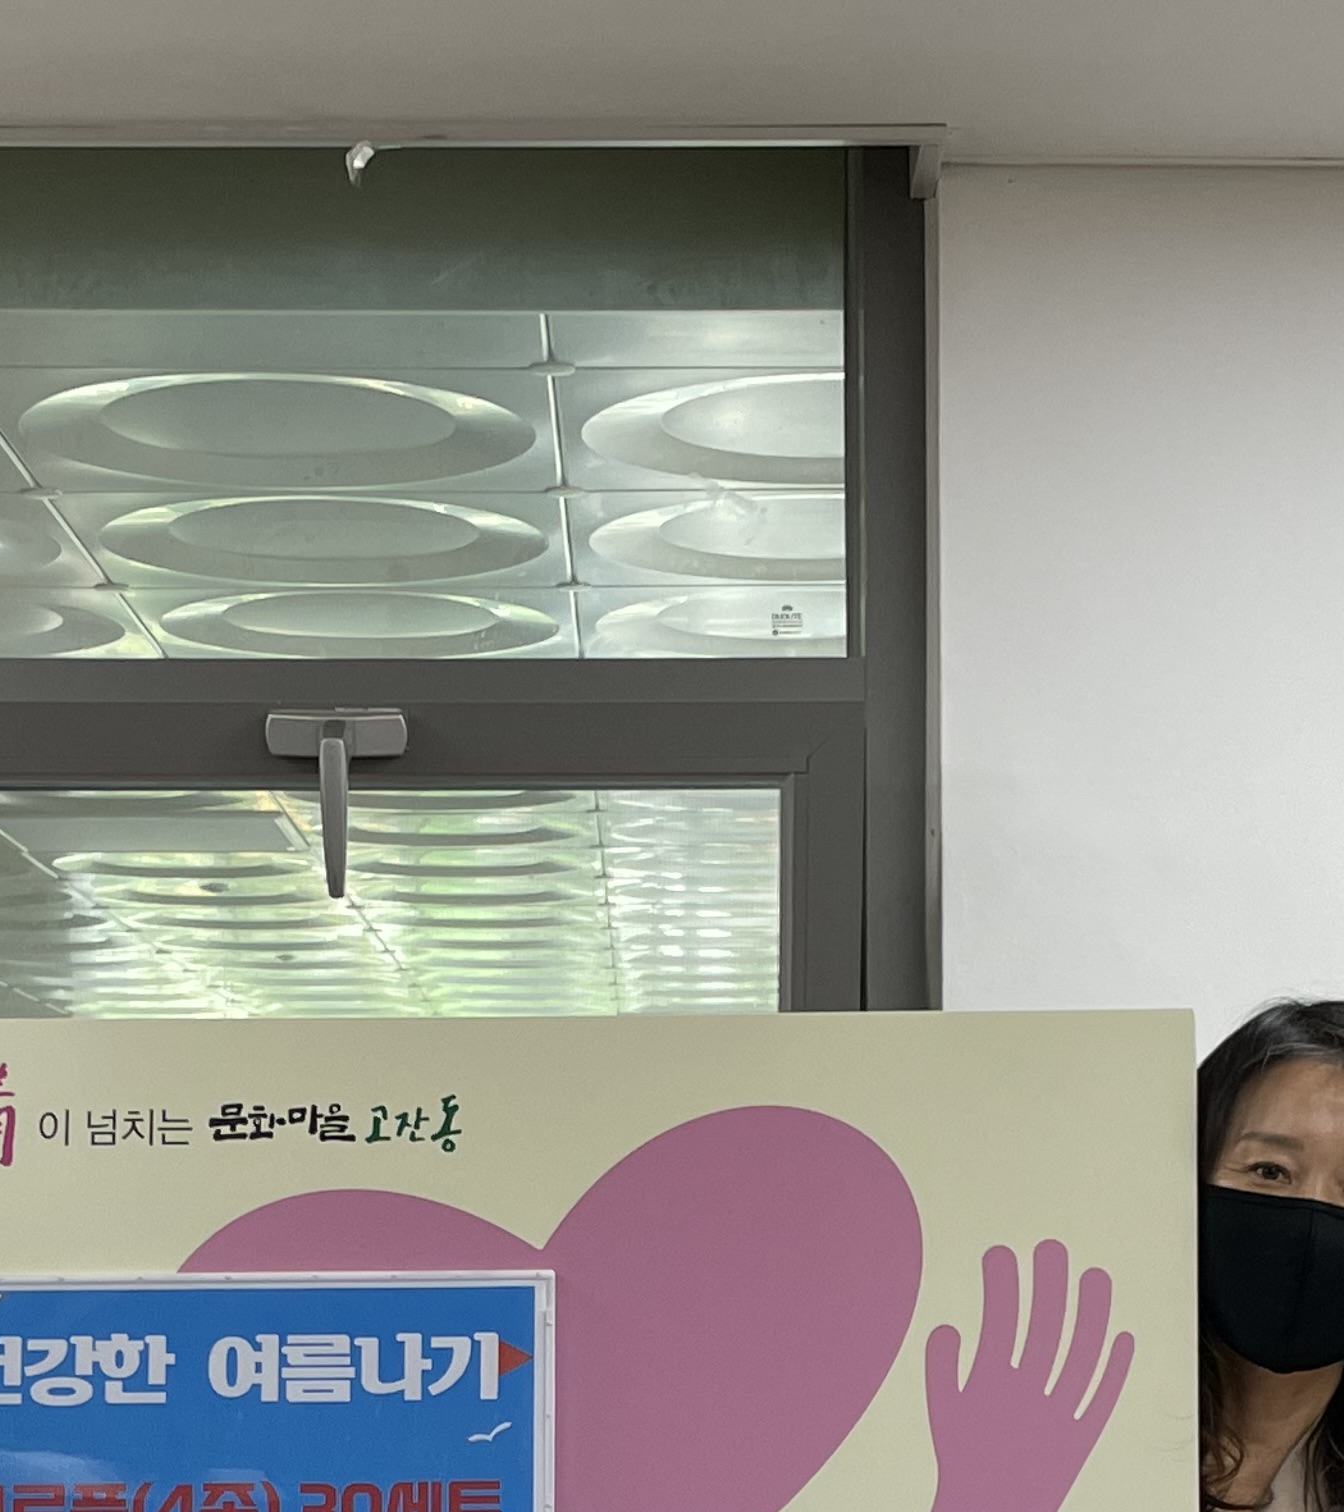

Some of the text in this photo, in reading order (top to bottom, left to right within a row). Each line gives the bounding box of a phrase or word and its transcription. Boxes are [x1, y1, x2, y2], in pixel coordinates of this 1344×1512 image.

[39, 1108, 70, 1147] 이
[86, 1108, 194, 1147] 넘치는
[364, 1093, 463, 1153] 고잔동
[207, 1331, 500, 1403] 여름나기
